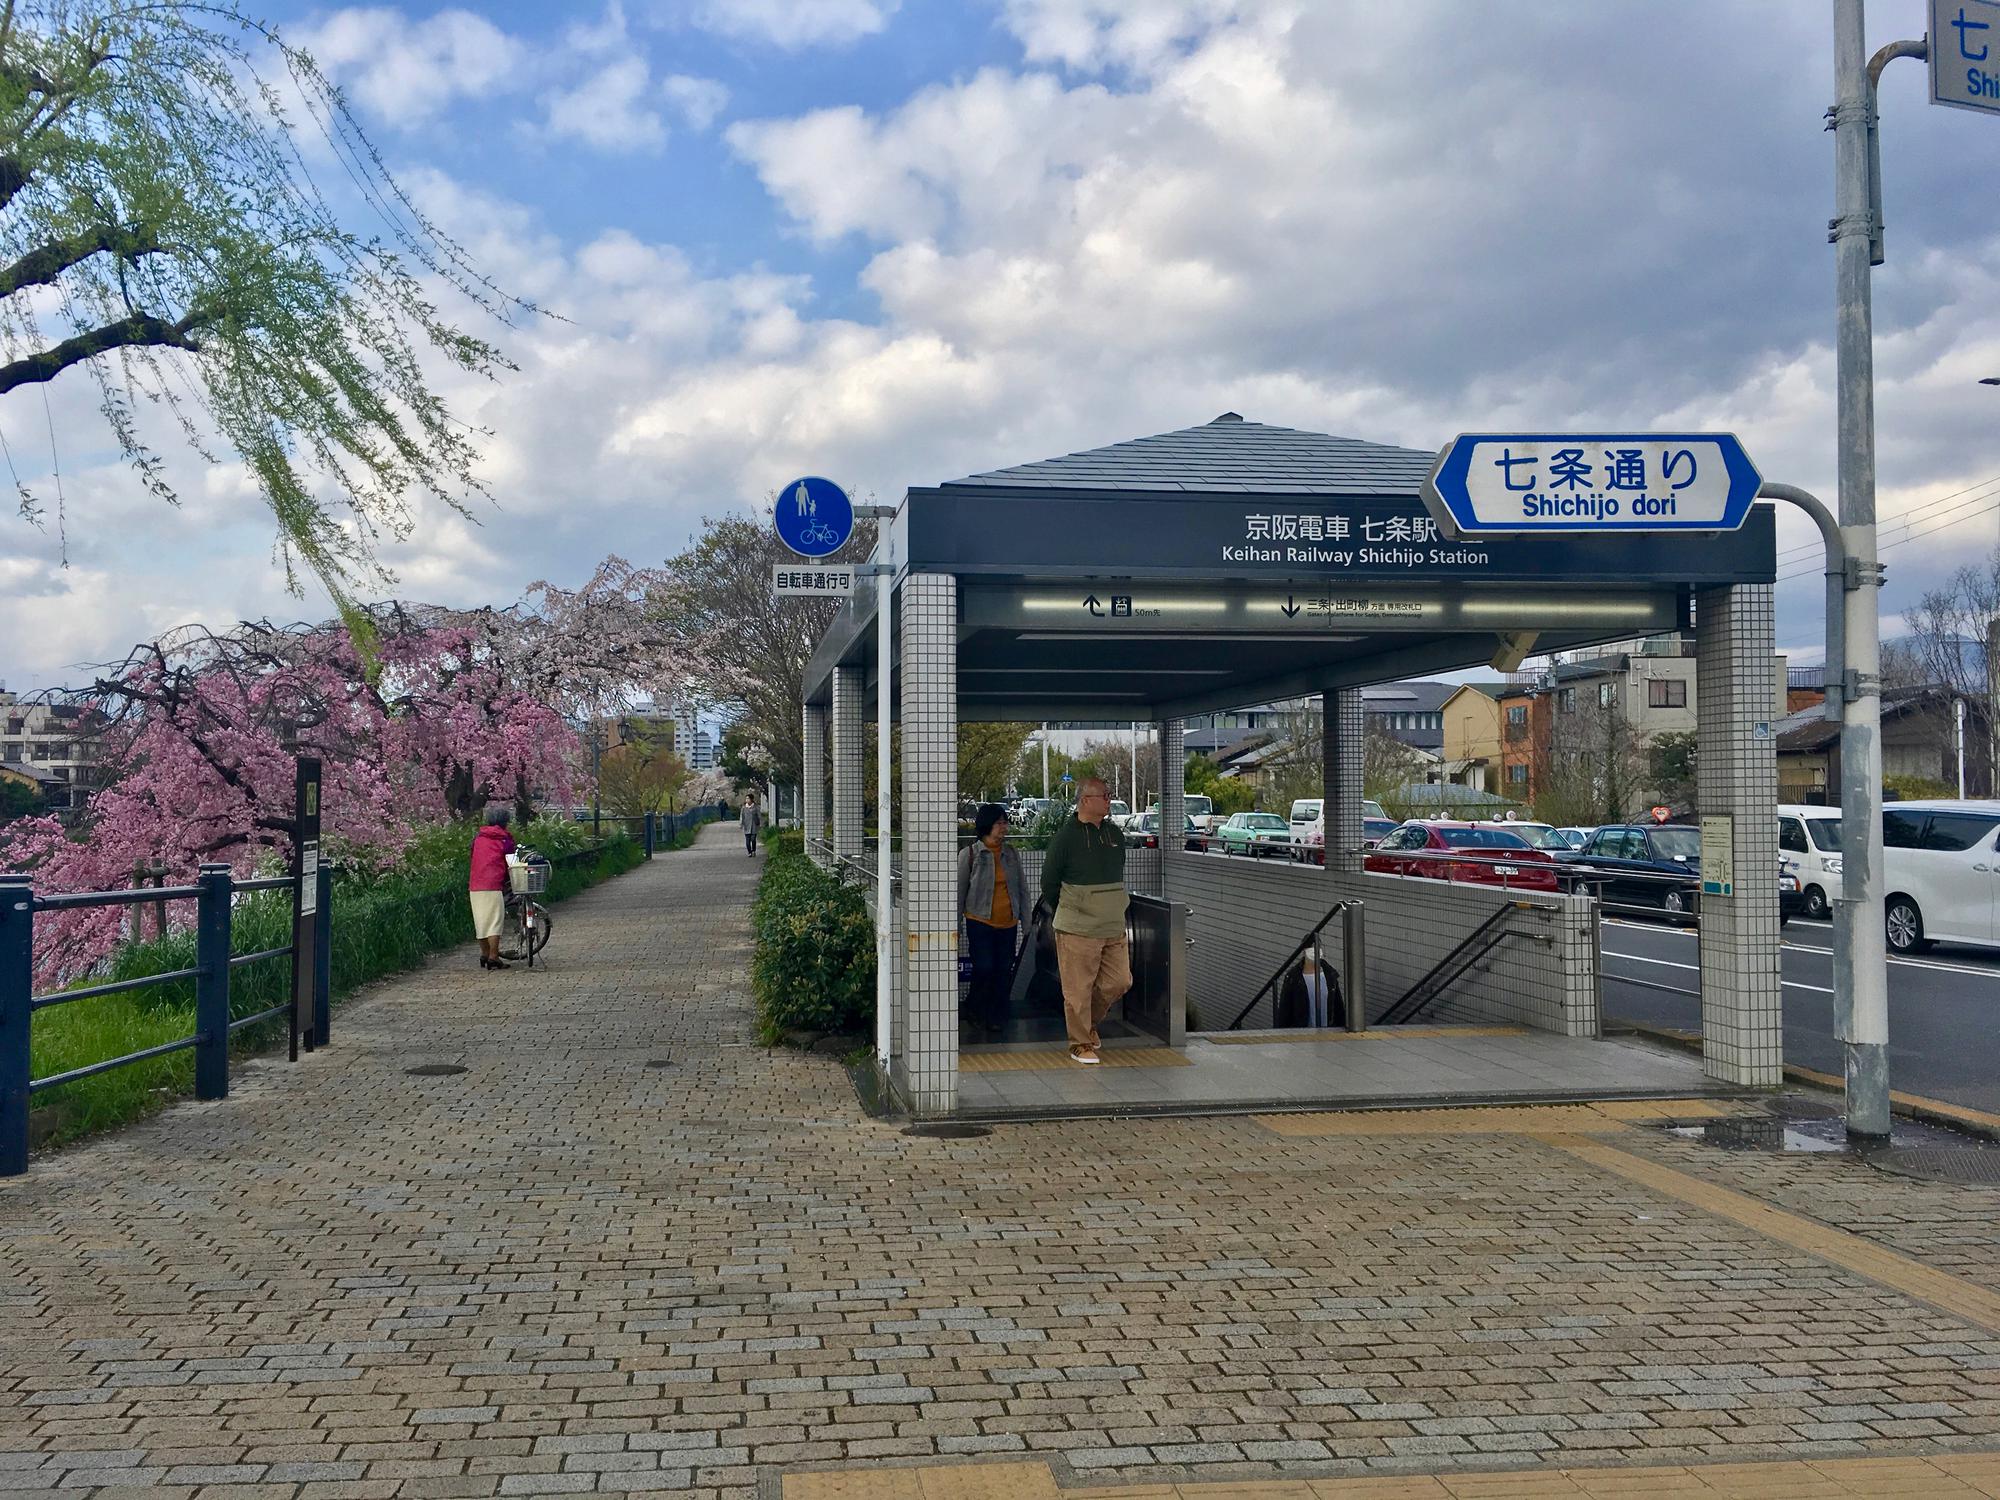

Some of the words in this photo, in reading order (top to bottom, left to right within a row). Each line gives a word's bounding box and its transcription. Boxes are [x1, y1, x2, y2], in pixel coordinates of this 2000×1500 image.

[1495, 448, 1697, 490] 七条通り
[1523, 493, 1619, 520] Shichijo
[1632, 493, 1676, 515] dori
[1245, 513, 1350, 541] 京阪電車
[1360, 516, 1438, 543] 七条駅
[1222, 546, 1281, 562] Keihan
[1287, 547, 1353, 566] Railway
[1359, 549, 1424, 567] Shichijo
[1430, 549, 1488, 564] Station
[777, 572, 850, 589] 自転車通行可
